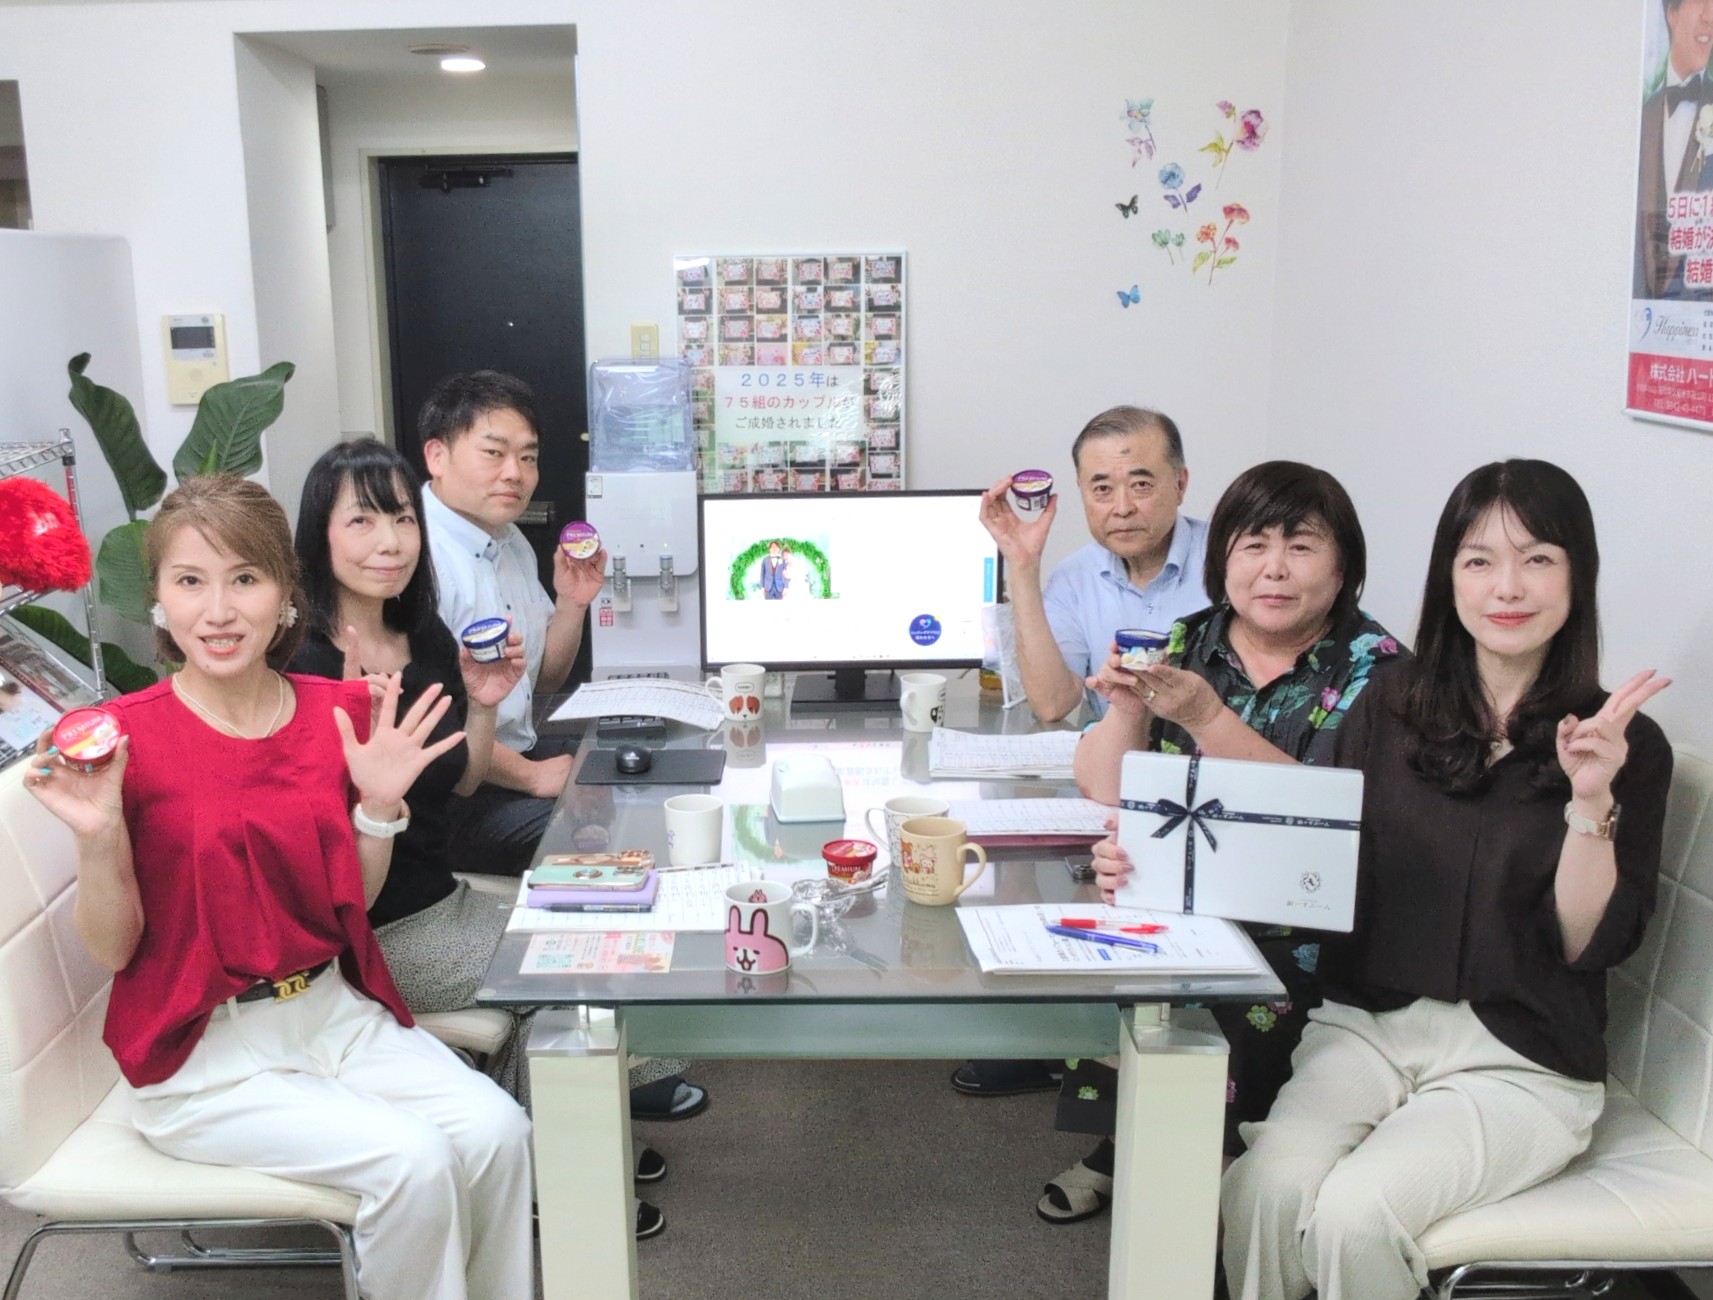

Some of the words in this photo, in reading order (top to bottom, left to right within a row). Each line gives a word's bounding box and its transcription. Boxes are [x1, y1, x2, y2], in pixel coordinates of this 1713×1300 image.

[1668, 195, 1713, 219] 5日に1
[740, 371, 840, 388] 2025年は
[61, 715, 102, 740] PREMIUM
